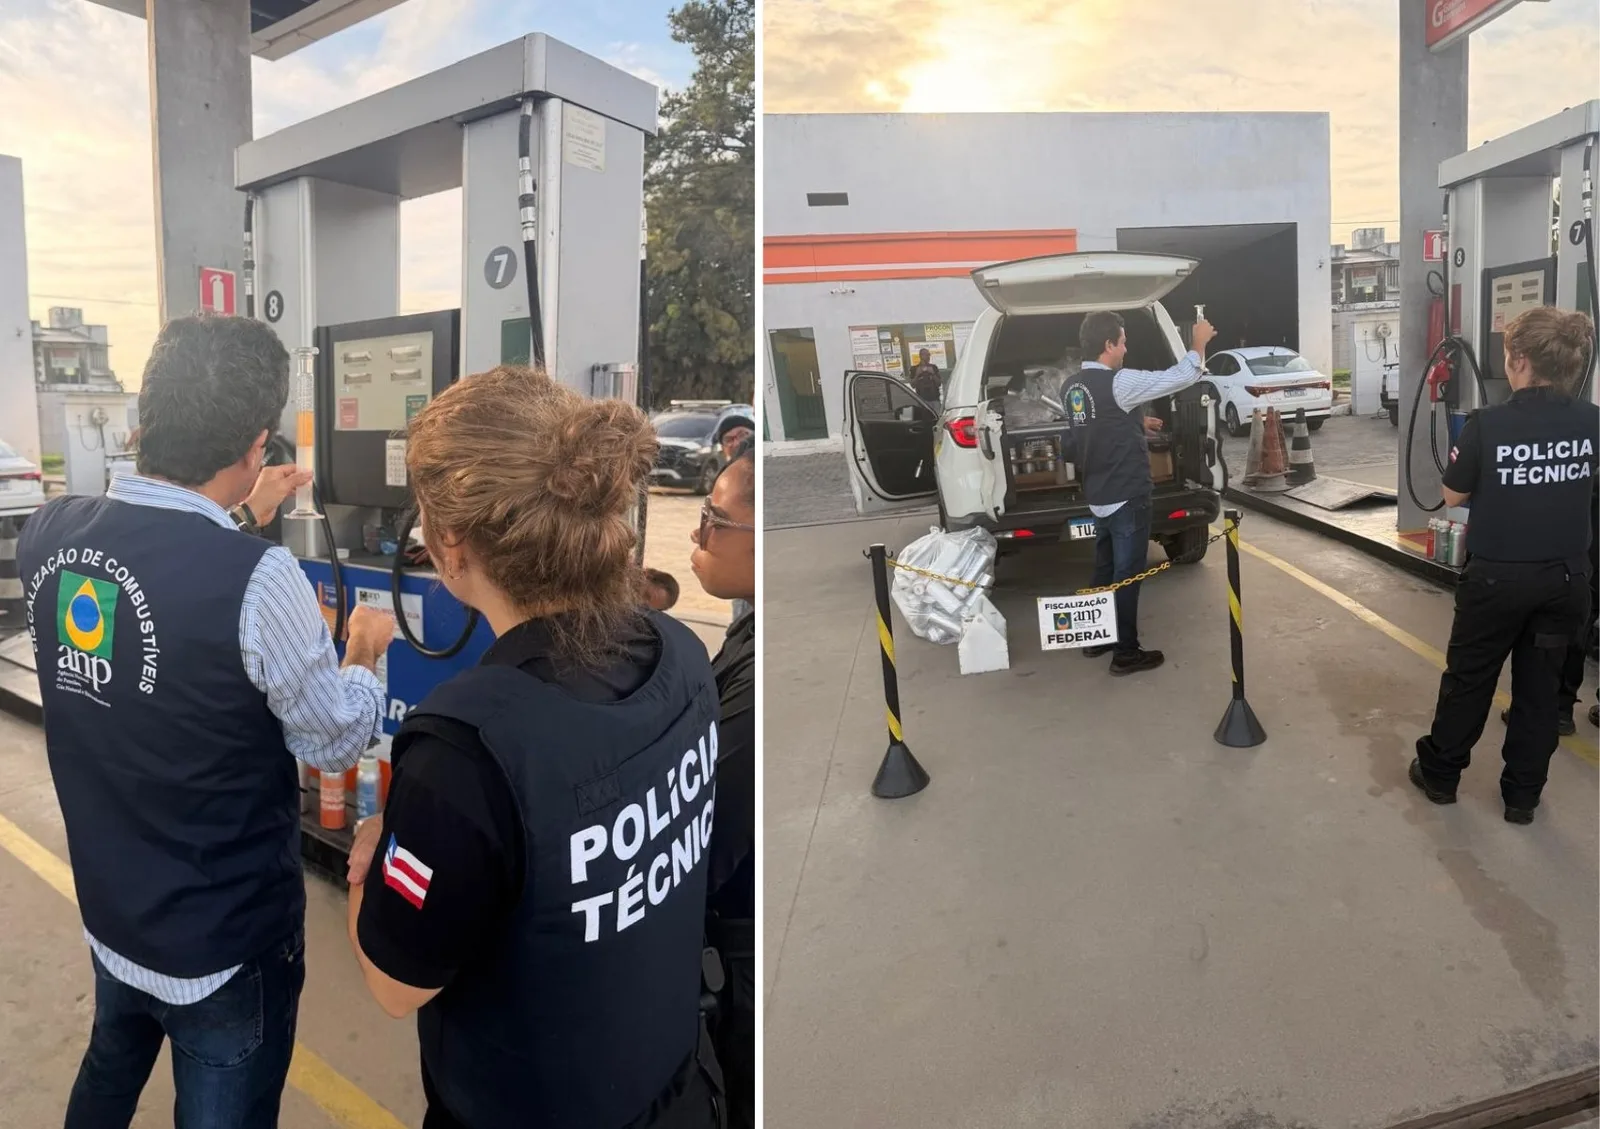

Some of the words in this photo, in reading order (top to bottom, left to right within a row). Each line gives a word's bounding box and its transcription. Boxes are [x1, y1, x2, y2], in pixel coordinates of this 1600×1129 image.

[1574, 225, 1581, 241] 7
[1456, 250, 1462, 264] 8
[494, 254, 508, 283] 7
[269, 295, 278, 317] 8
[1497, 462, 1590, 485] TÉCNICA
[1045, 597, 1108, 610] FISCALIZAÇÃO
[81, 548, 103, 567] DE
[105, 558, 160, 694] COMBUSTÍVEIS
[1073, 608, 1101, 623] anp
[1047, 629, 1111, 644] FEDERAL
[57, 644, 112, 693] anp
[571, 782, 716, 942] TÉCNIC
